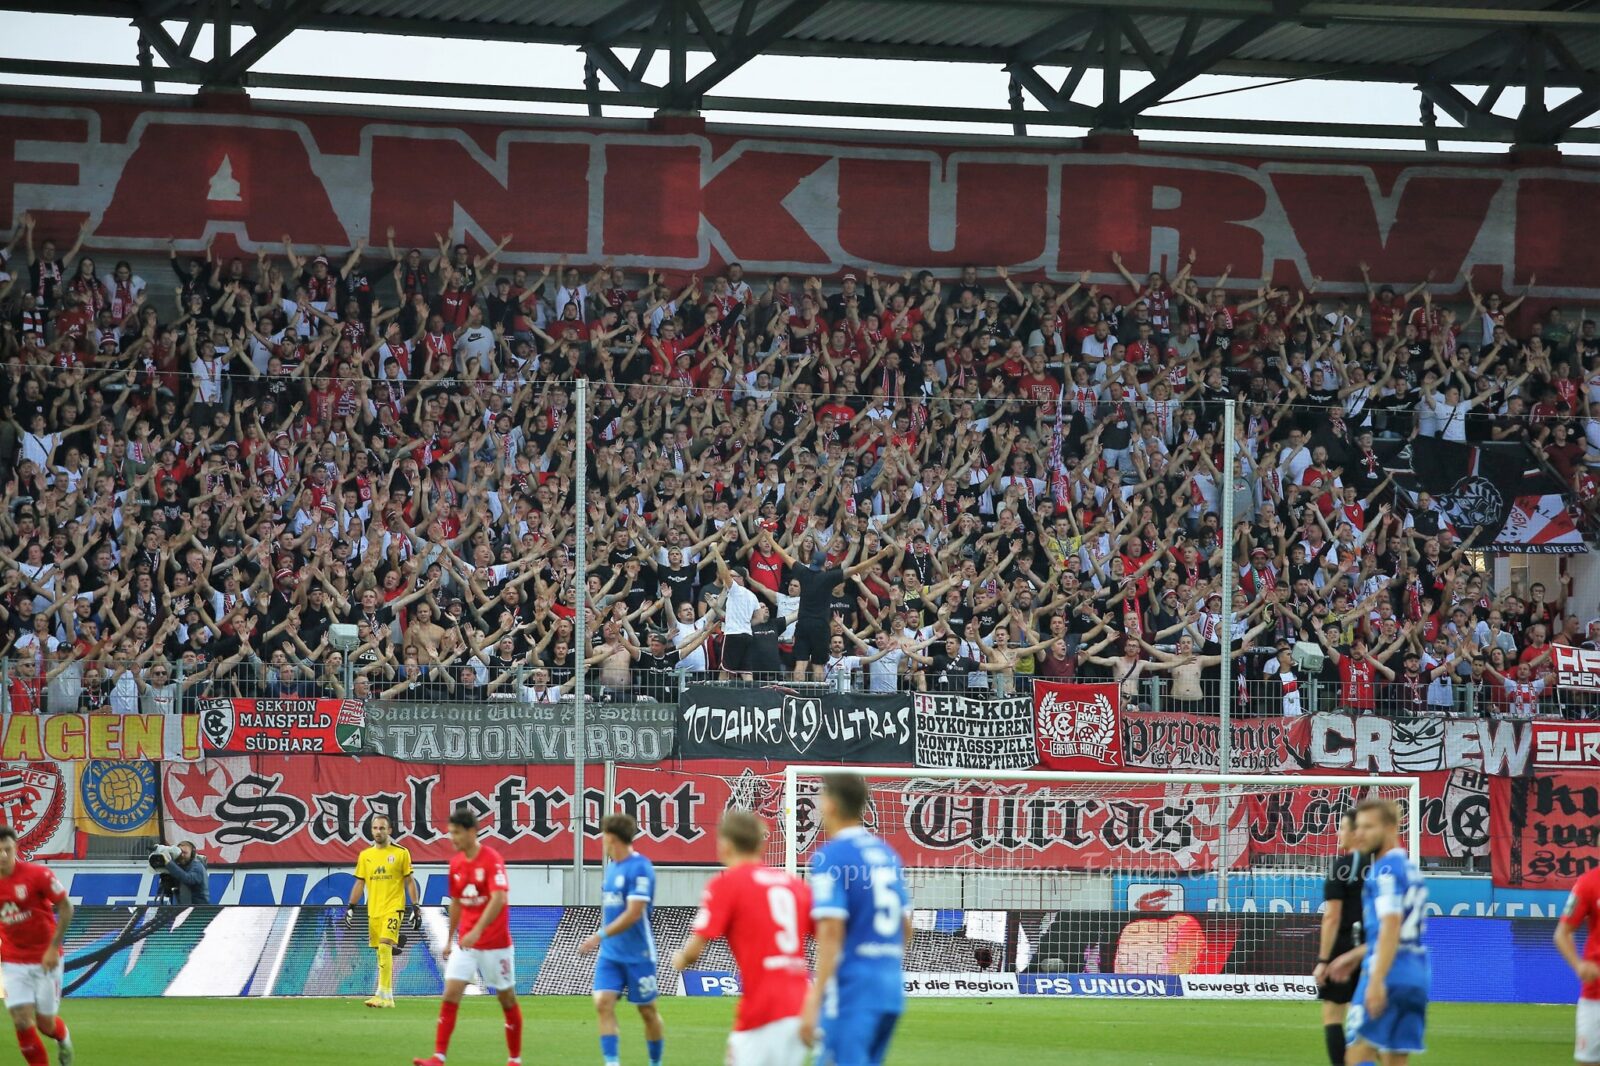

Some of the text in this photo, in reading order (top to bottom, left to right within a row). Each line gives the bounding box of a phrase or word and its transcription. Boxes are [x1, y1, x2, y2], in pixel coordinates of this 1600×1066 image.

[1544, 545, 1588, 554] SIEGEN
[200, 698, 224, 710] HFC
[256, 700, 317, 713] SEKTION
[915, 695, 1032, 719] TELEKOM
[1053, 703, 1071, 712] HFC
[1083, 704, 1097, 714] FC
[239, 713, 332, 729] MANSFELD
[822, 706, 911, 745] ULTRAS
[916, 716, 1032, 736] BOYKOTTIEREN
[1077, 712, 1101, 723] RWE
[245, 734, 324, 751] SÜDHARZ
[917, 735, 1035, 753] MONTAGSSPIELE
[918, 751, 1037, 769] NICHT AKZEPTIEREN
[1151, 747, 1280, 771] ist Leideschaft
[213, 772, 707, 845] Saalefront
[902, 776, 1195, 853] Ultras
[872, 866, 901, 937] 5
[387, 918, 398, 930] 23
[767, 885, 799, 954] 9
[700, 976, 739, 993] PS
[925, 979, 950, 991] die
[955, 979, 1014, 993] Region
[1035, 978, 1167, 995] PS UNION
[1187, 981, 1319, 995] bewegt die Reg
